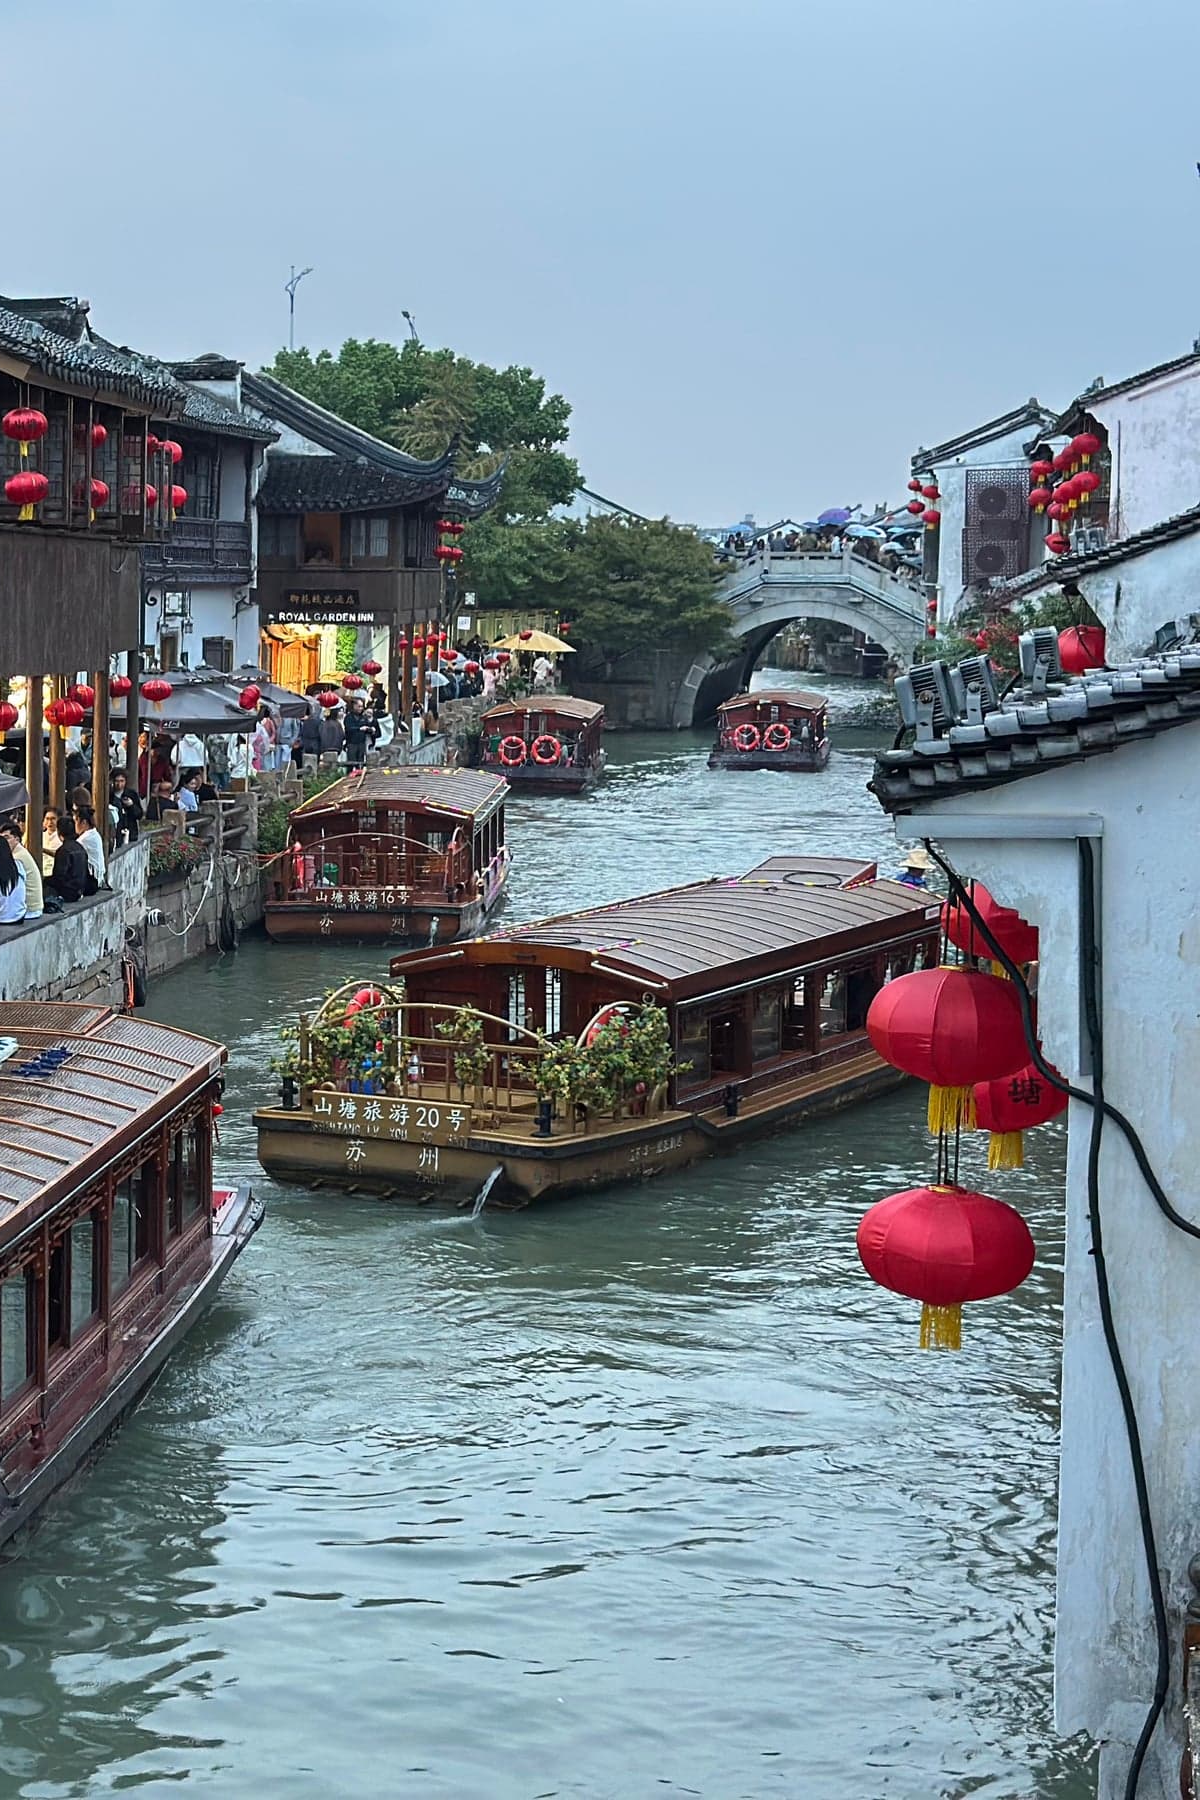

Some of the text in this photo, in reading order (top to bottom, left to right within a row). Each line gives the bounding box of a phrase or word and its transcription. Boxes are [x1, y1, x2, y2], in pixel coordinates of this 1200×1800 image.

[278, 611, 374, 622] ROYAL GARDEN INN
[315, 890, 411, 905] 山塘旅游16号
[1008, 1077, 1042, 1105] 塘
[314, 1096, 466, 1133] 山塘旅游20号
